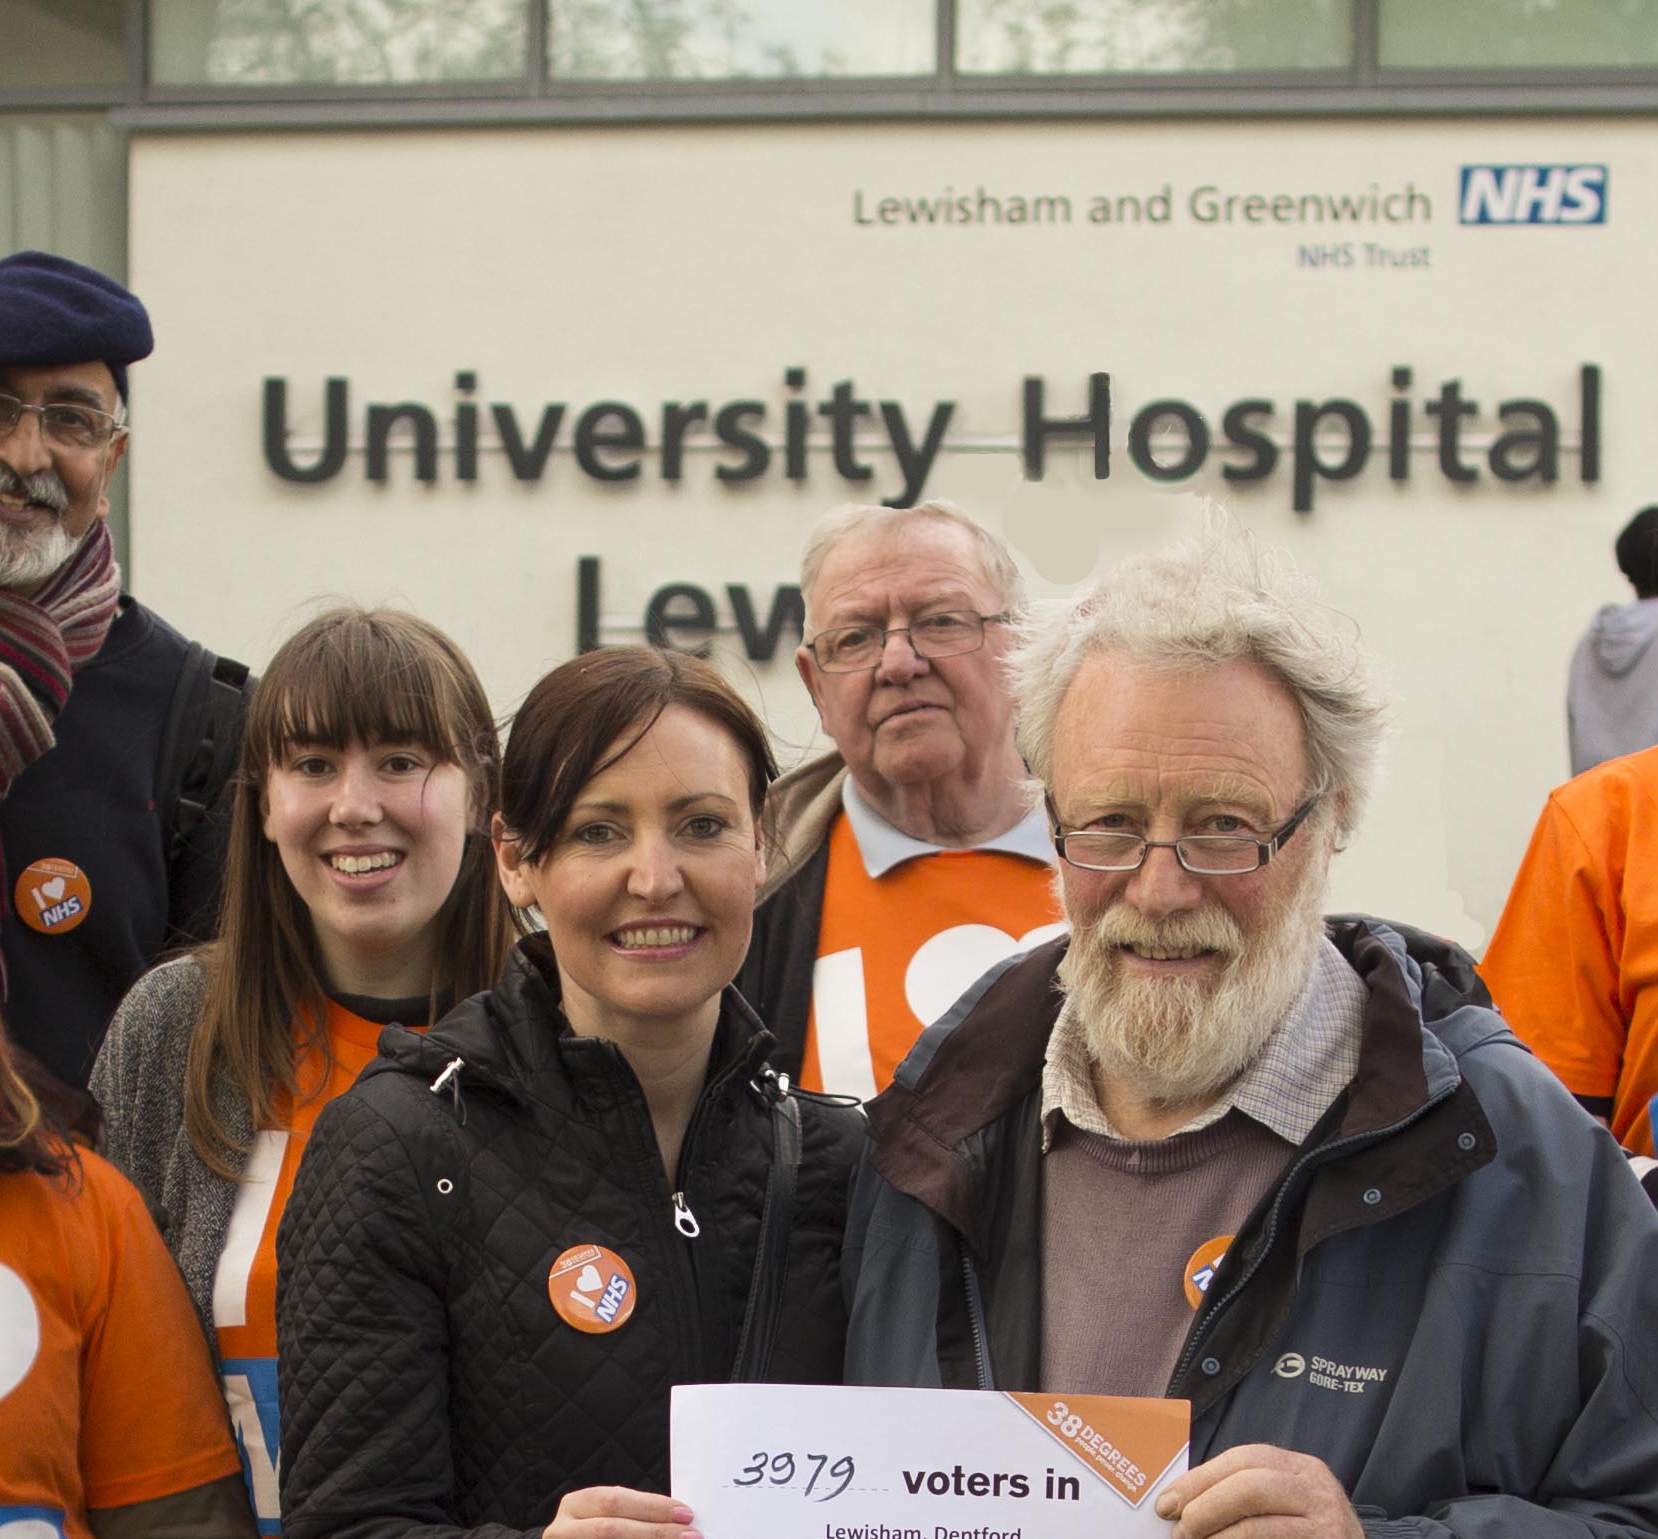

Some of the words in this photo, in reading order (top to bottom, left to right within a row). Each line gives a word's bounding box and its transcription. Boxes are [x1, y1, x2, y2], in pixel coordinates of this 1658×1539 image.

[852, 187, 1072, 225] Lewisham
[1088, 185, 1174, 224] and
[1188, 185, 1433, 225] Greenwich
[1461, 166, 1604, 222] NHS
[1298, 243, 1355, 269] NHS
[1365, 243, 1431, 269] Trust
[262, 367, 956, 508] University
[1022, 363, 1601, 512] Hospital
[42, 895, 81, 928] NHS
[596, 1274, 628, 1323] NHS
[1309, 1371, 1366, 1394] GORE-TEX
[1311, 1355, 1388, 1382] SPRAYWAY
[1046, 1400, 1084, 1438] 38
[1079, 1424, 1148, 1487] DEGREES
[732, 1451, 856, 1503] 3979
[901, 1465, 1031, 1501] voters
[1044, 1468, 1081, 1501] in
